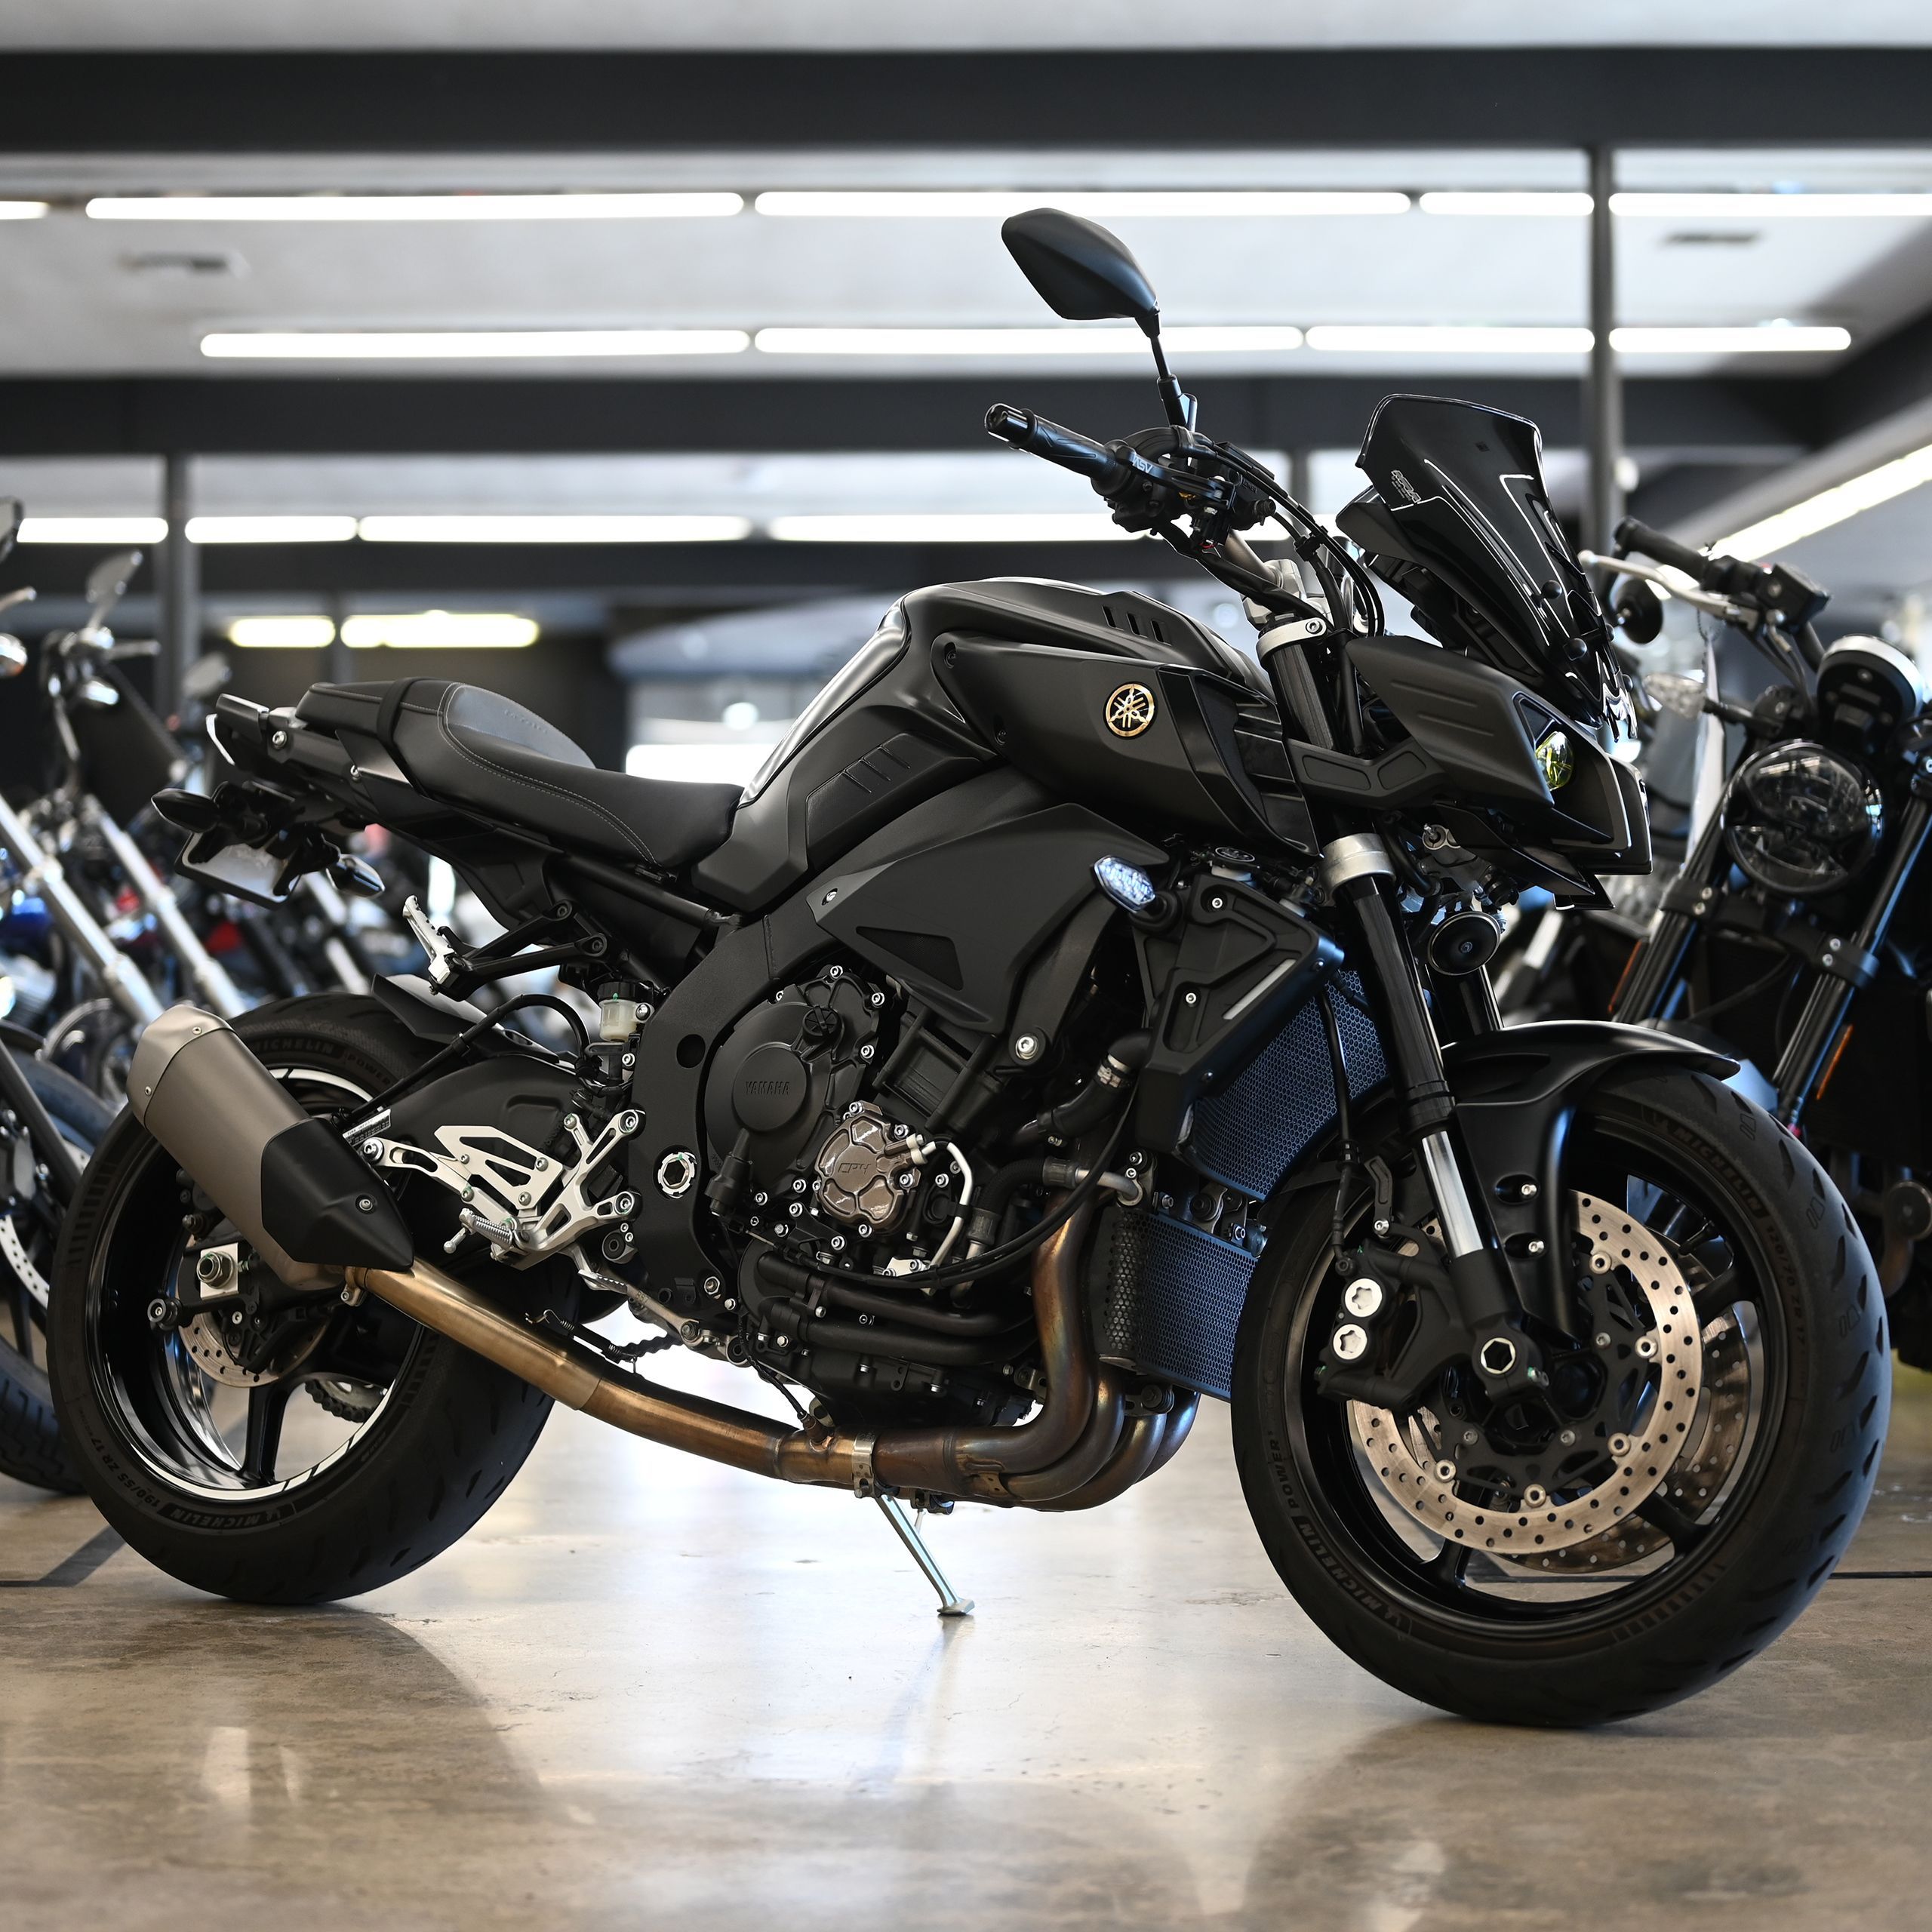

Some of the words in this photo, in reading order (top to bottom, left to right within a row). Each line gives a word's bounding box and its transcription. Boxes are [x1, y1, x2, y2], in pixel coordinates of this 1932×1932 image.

[1132, 457, 1152, 472] ASV
[347, 1055, 391, 1086] POWER
[746, 1081, 789, 1095] YAMAHA
[838, 1163, 871, 1174] CP4
[1672, 1128, 1761, 1211] MICHELIN
[1765, 1226, 1795, 1287] 120/70
[1792, 1296, 1802, 1318] ZR
[1797, 1325, 1805, 1344] 17
[89, 1437, 105, 1453] 17
[100, 1454, 121, 1472] ZR
[1270, 1439, 1299, 1509] POWER
[117, 1473, 160, 1509] 190/55
[171, 1508, 260, 1530] MICHELIN
[1298, 1523, 1383, 1611] MICHELIN
